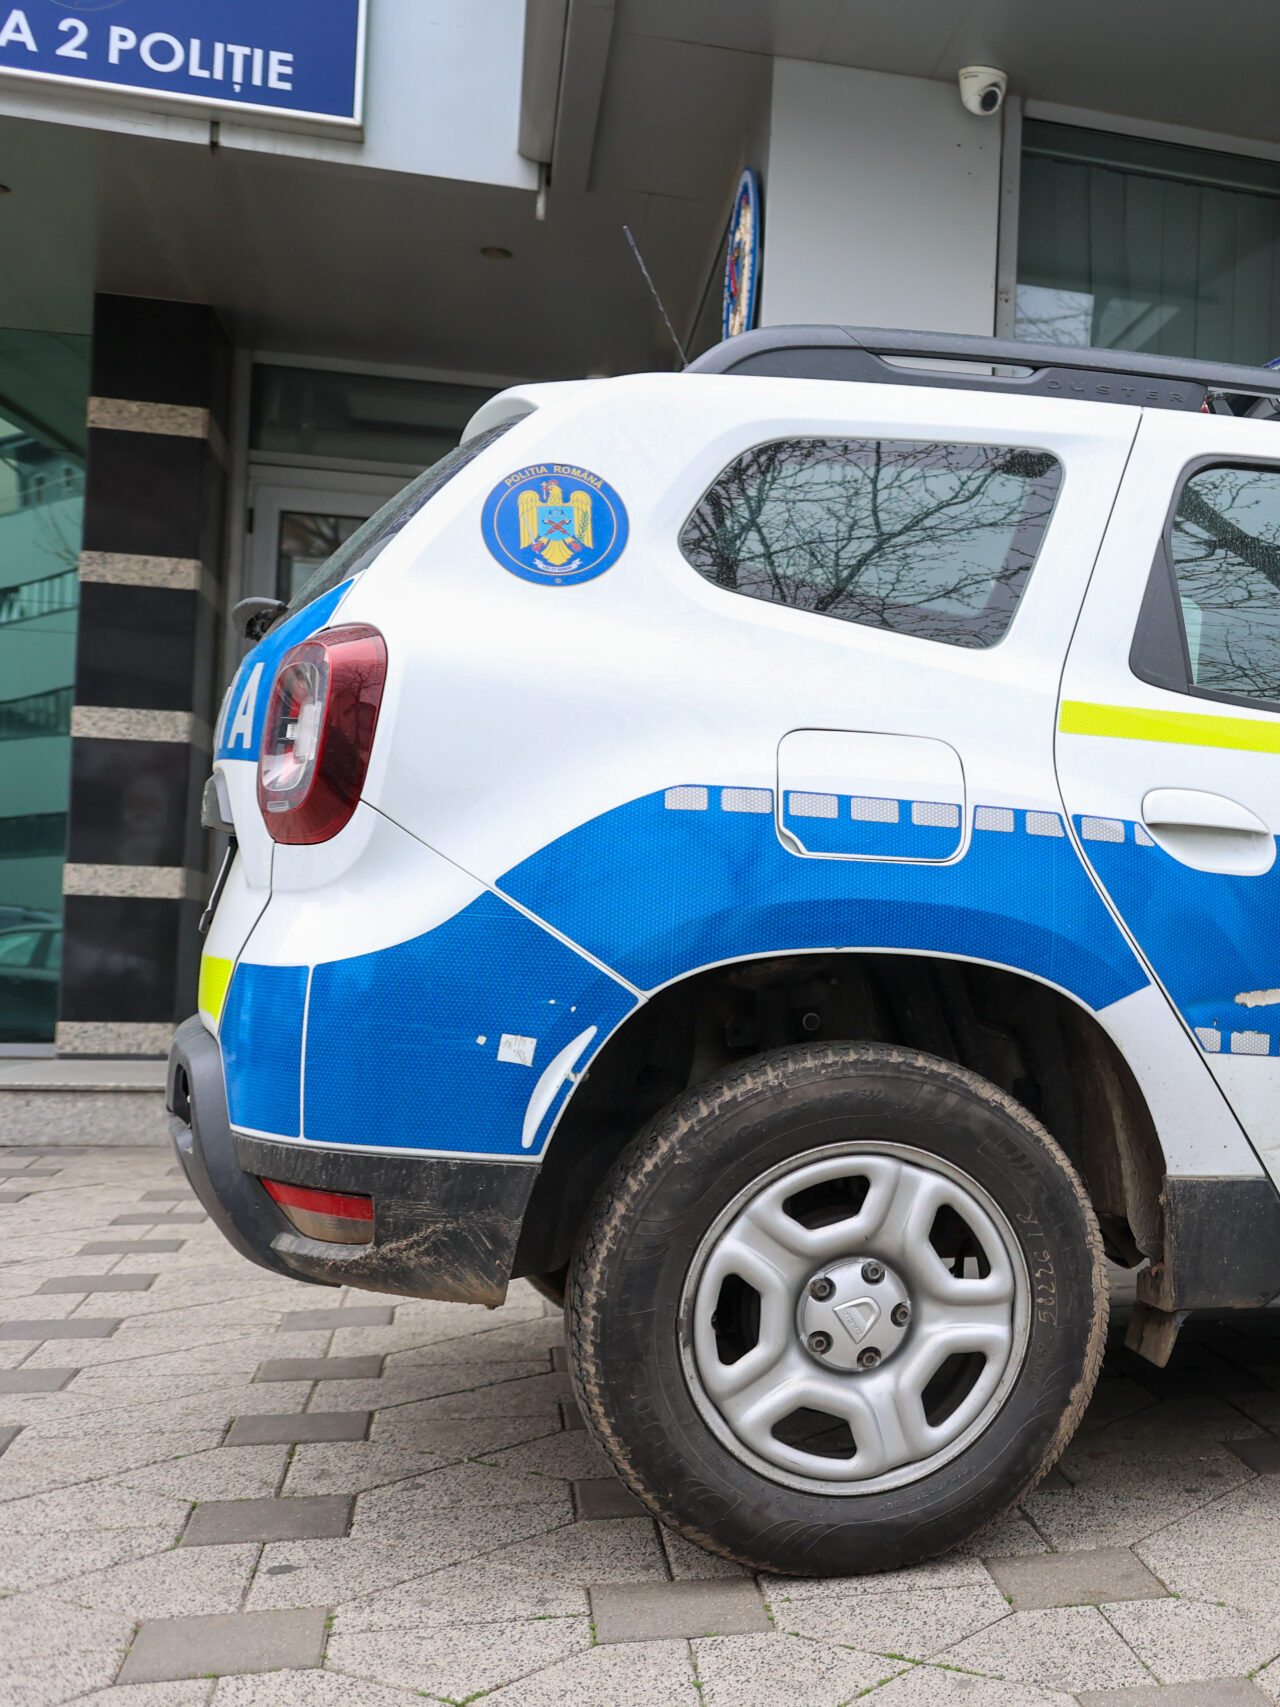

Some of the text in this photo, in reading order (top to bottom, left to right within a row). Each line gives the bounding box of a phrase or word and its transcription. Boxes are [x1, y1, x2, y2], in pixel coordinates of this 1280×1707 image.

[55, 17, 89, 60] 2
[108, 25, 294, 93] POLIȚIE
[1047, 379, 1183, 403] DUSTER
